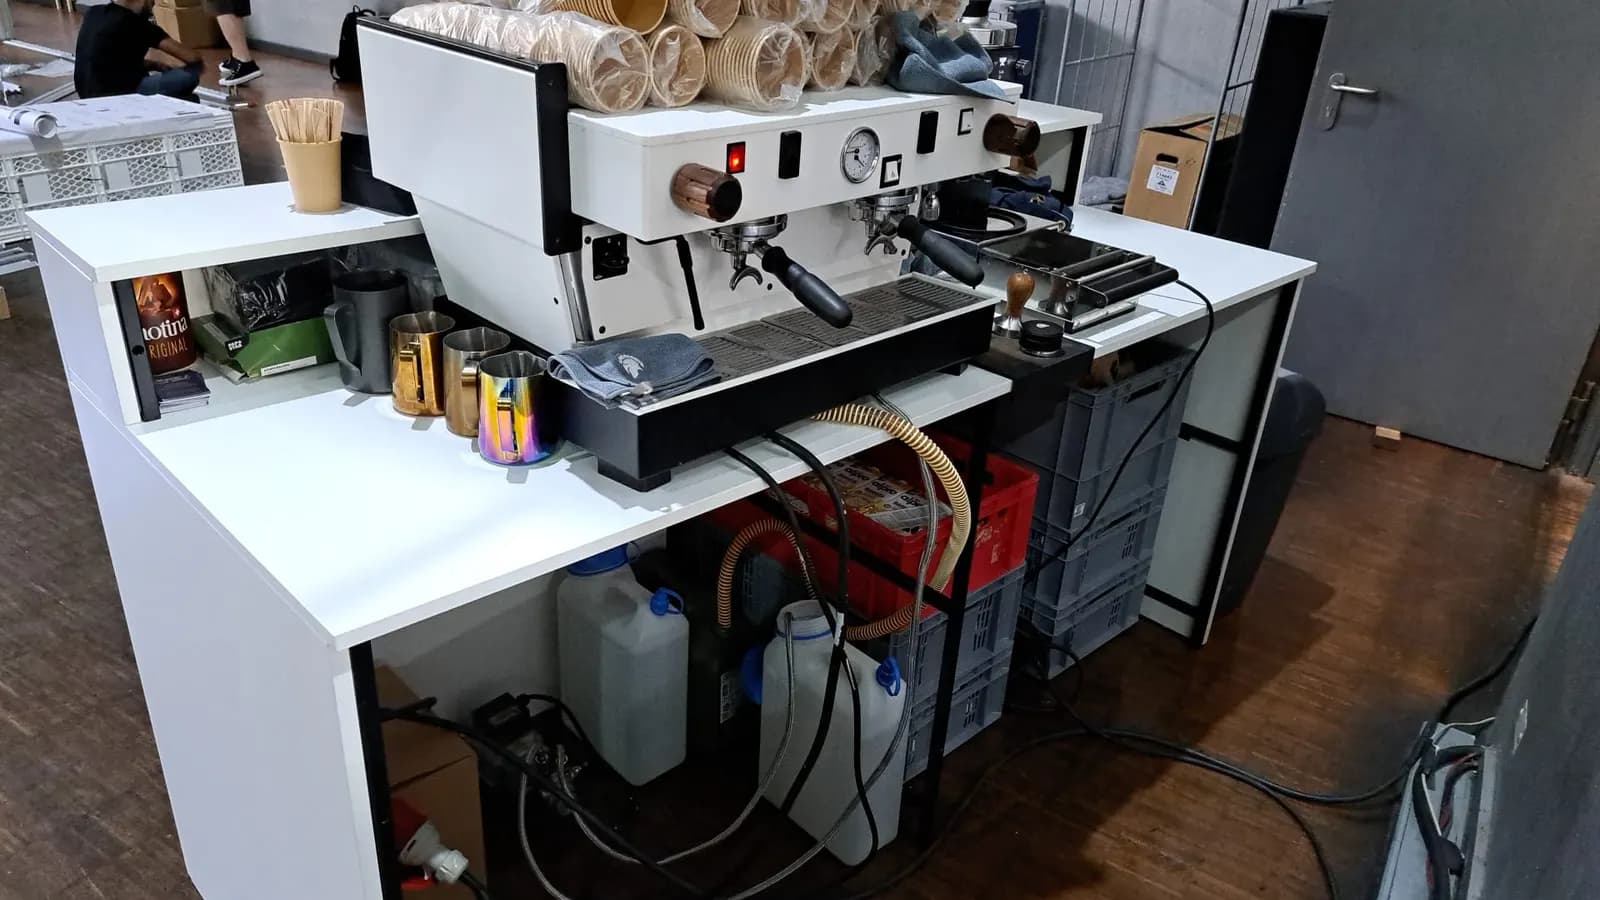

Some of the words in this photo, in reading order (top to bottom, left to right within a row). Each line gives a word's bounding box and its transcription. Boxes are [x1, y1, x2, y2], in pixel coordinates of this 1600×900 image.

[142, 316, 188, 341] otina
[149, 338, 187, 359] RIGINAL
[872, 481, 898, 495] alpro
